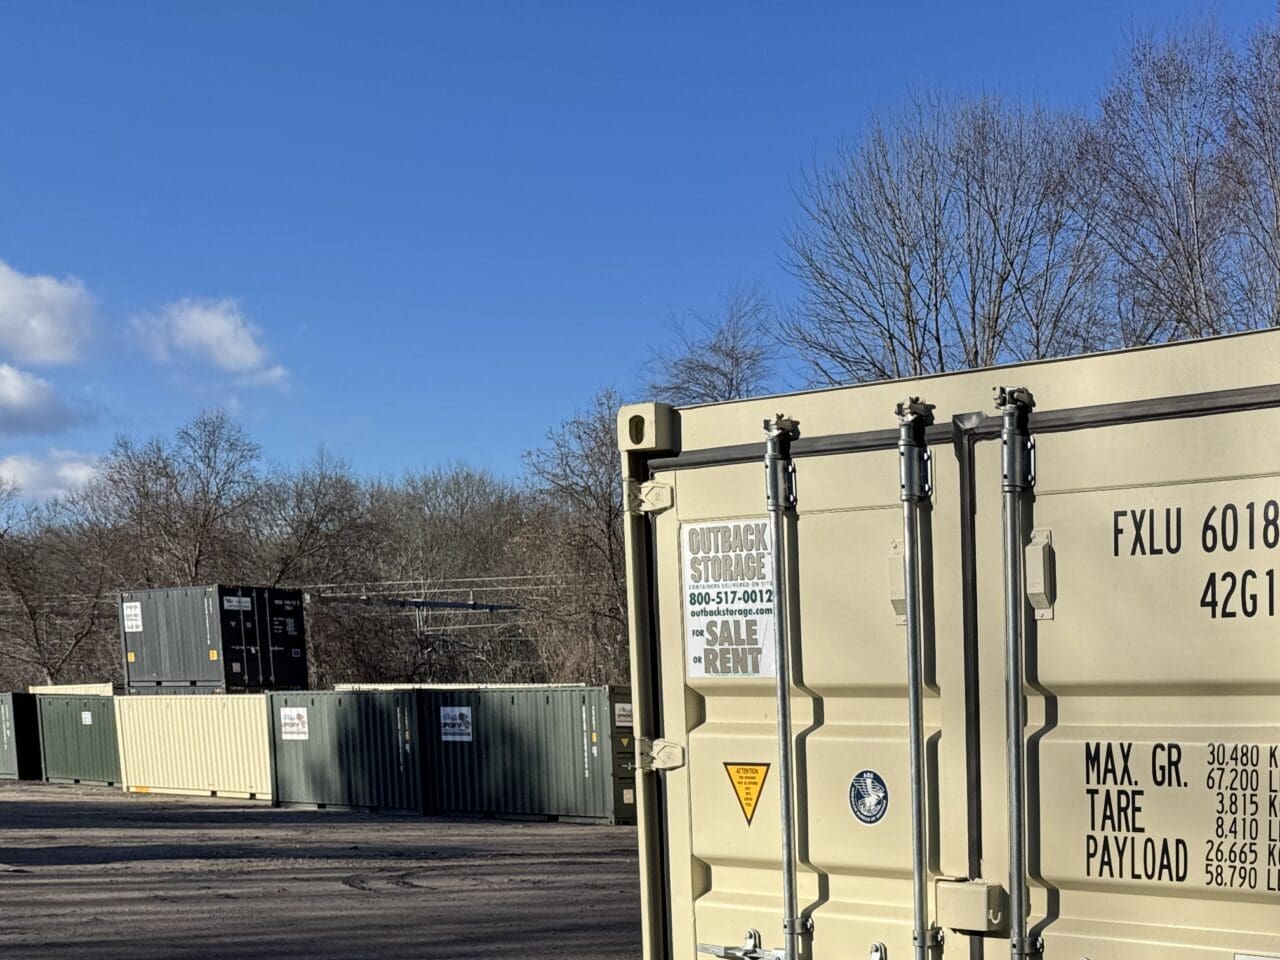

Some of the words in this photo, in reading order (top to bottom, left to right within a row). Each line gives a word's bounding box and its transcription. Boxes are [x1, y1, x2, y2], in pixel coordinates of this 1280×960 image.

[688, 523, 768, 555] OUTBACK
[1113, 507, 1182, 557] FXLU
[690, 552, 766, 583] STORAGE
[689, 589, 773, 606] 800-517-0012
[1199, 568, 1275, 619] 42G1
[690, 606, 773, 618] outbackstorage.com
[692, 629, 705, 638] FOR
[706, 619, 759, 647] SALE
[693, 656, 702, 664] OR
[704, 647, 762, 674] RENT
[1085, 741, 1139, 787] MAX.
[1151, 742, 1188, 788] GR.
[1085, 788, 1146, 834] TARE
[1086, 834, 1188, 883] PAYLOAD
